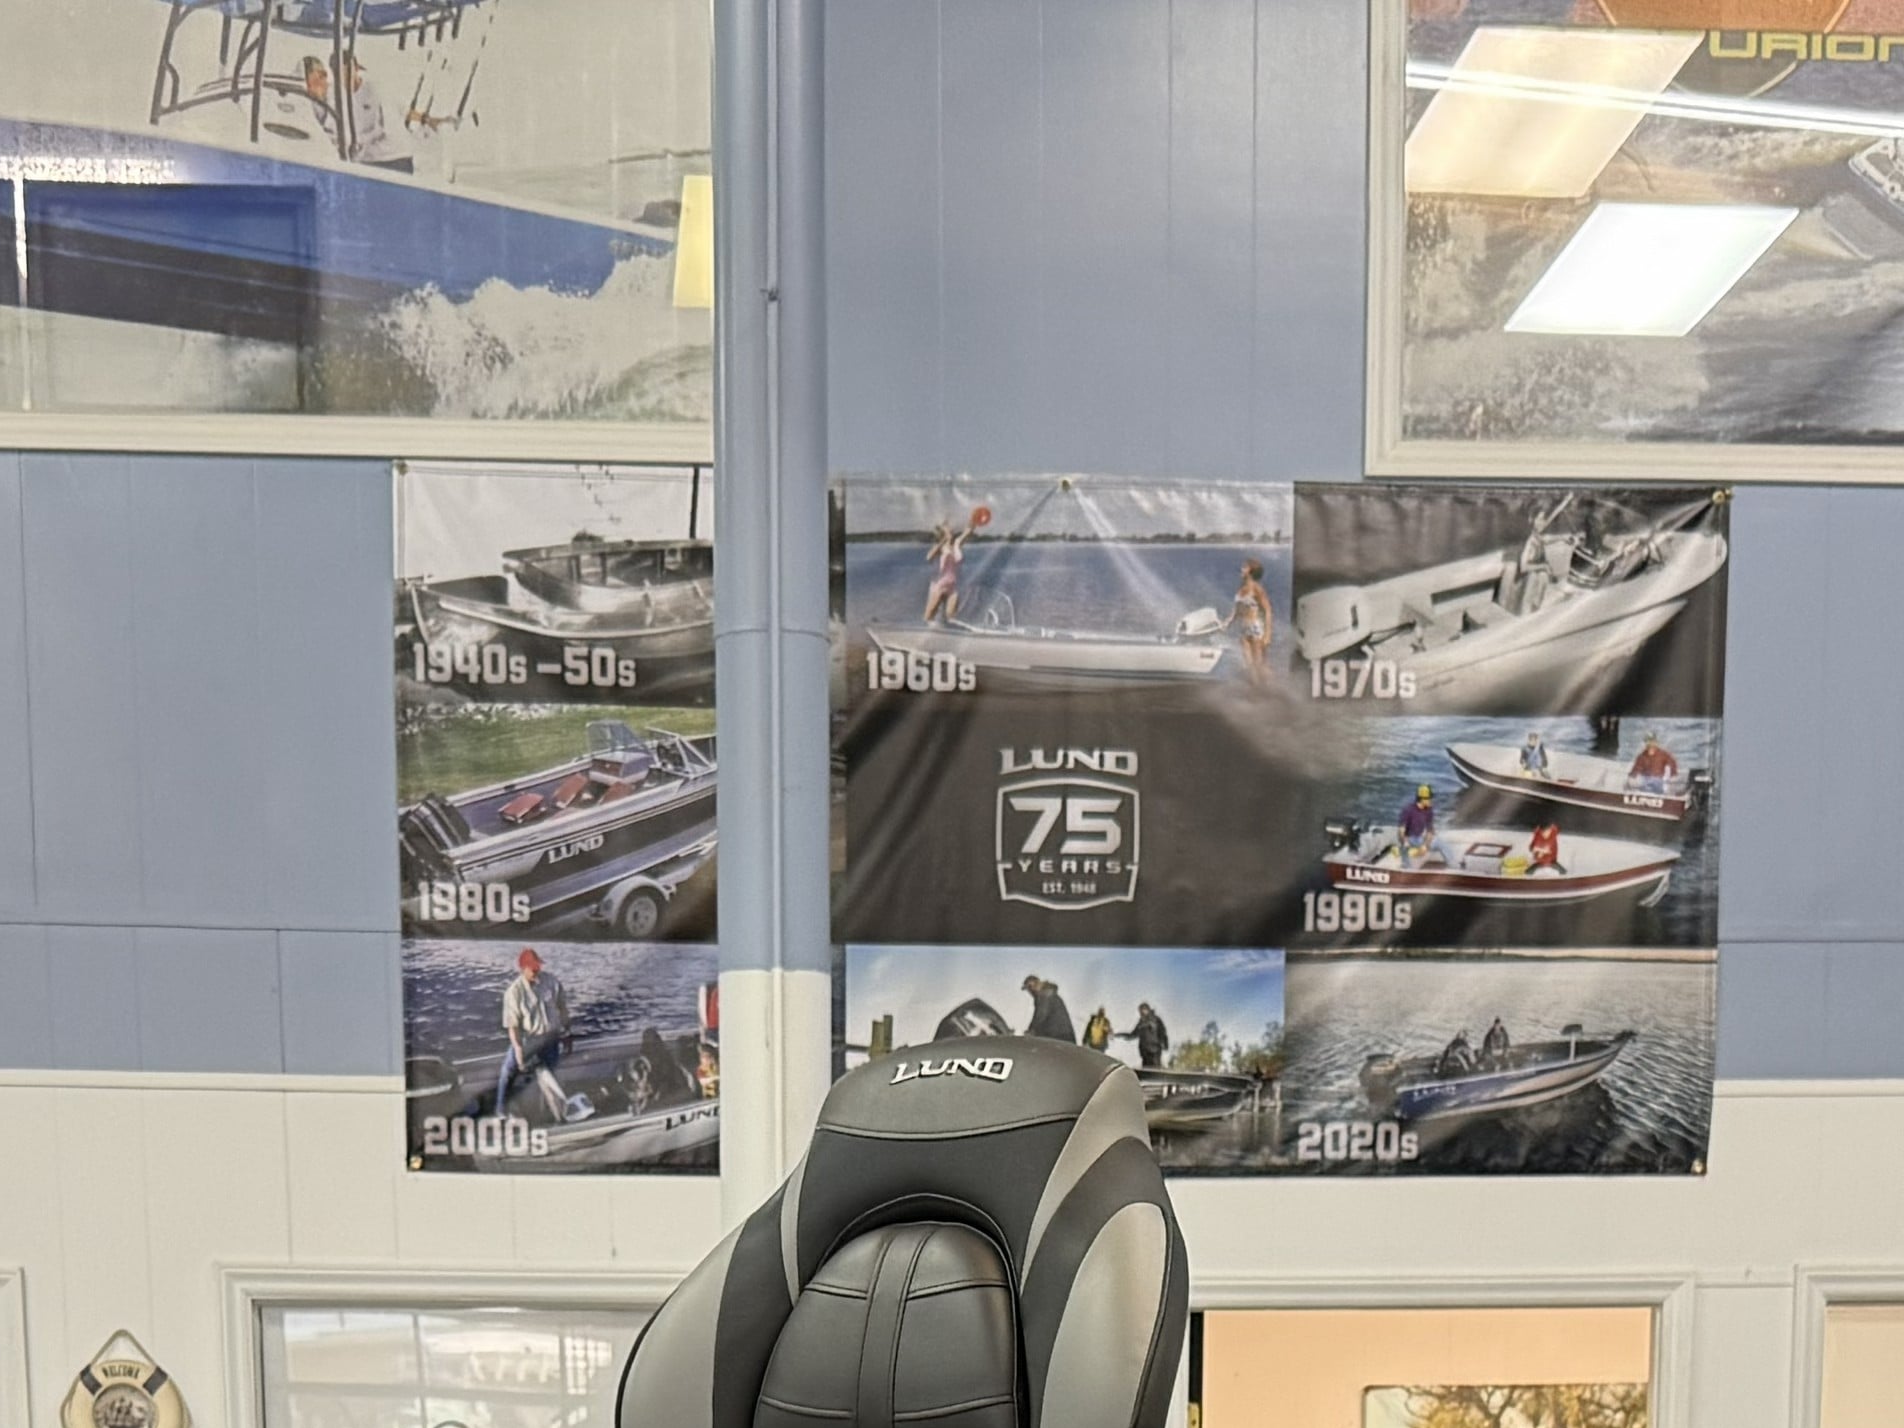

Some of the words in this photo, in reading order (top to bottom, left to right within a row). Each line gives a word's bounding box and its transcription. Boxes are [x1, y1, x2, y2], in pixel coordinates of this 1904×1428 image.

[412, 643, 528, 684] 1940s
[865, 651, 978, 692] 1960s
[1309, 659, 1417, 700] 1970s
[998, 747, 1139, 776] LUND
[1008, 797, 1124, 855] 75
[547, 834, 604, 864] LUND
[1015, 859, 1122, 875] YEARS
[1345, 866, 1391, 885] LUND
[417, 882, 531, 923] 1980s
[1302, 892, 1413, 933] 1990s
[889, 1057, 1015, 1086] LUND
[423, 1116, 548, 1157] 2000s
[1297, 1121, 1419, 1162] 2020s
